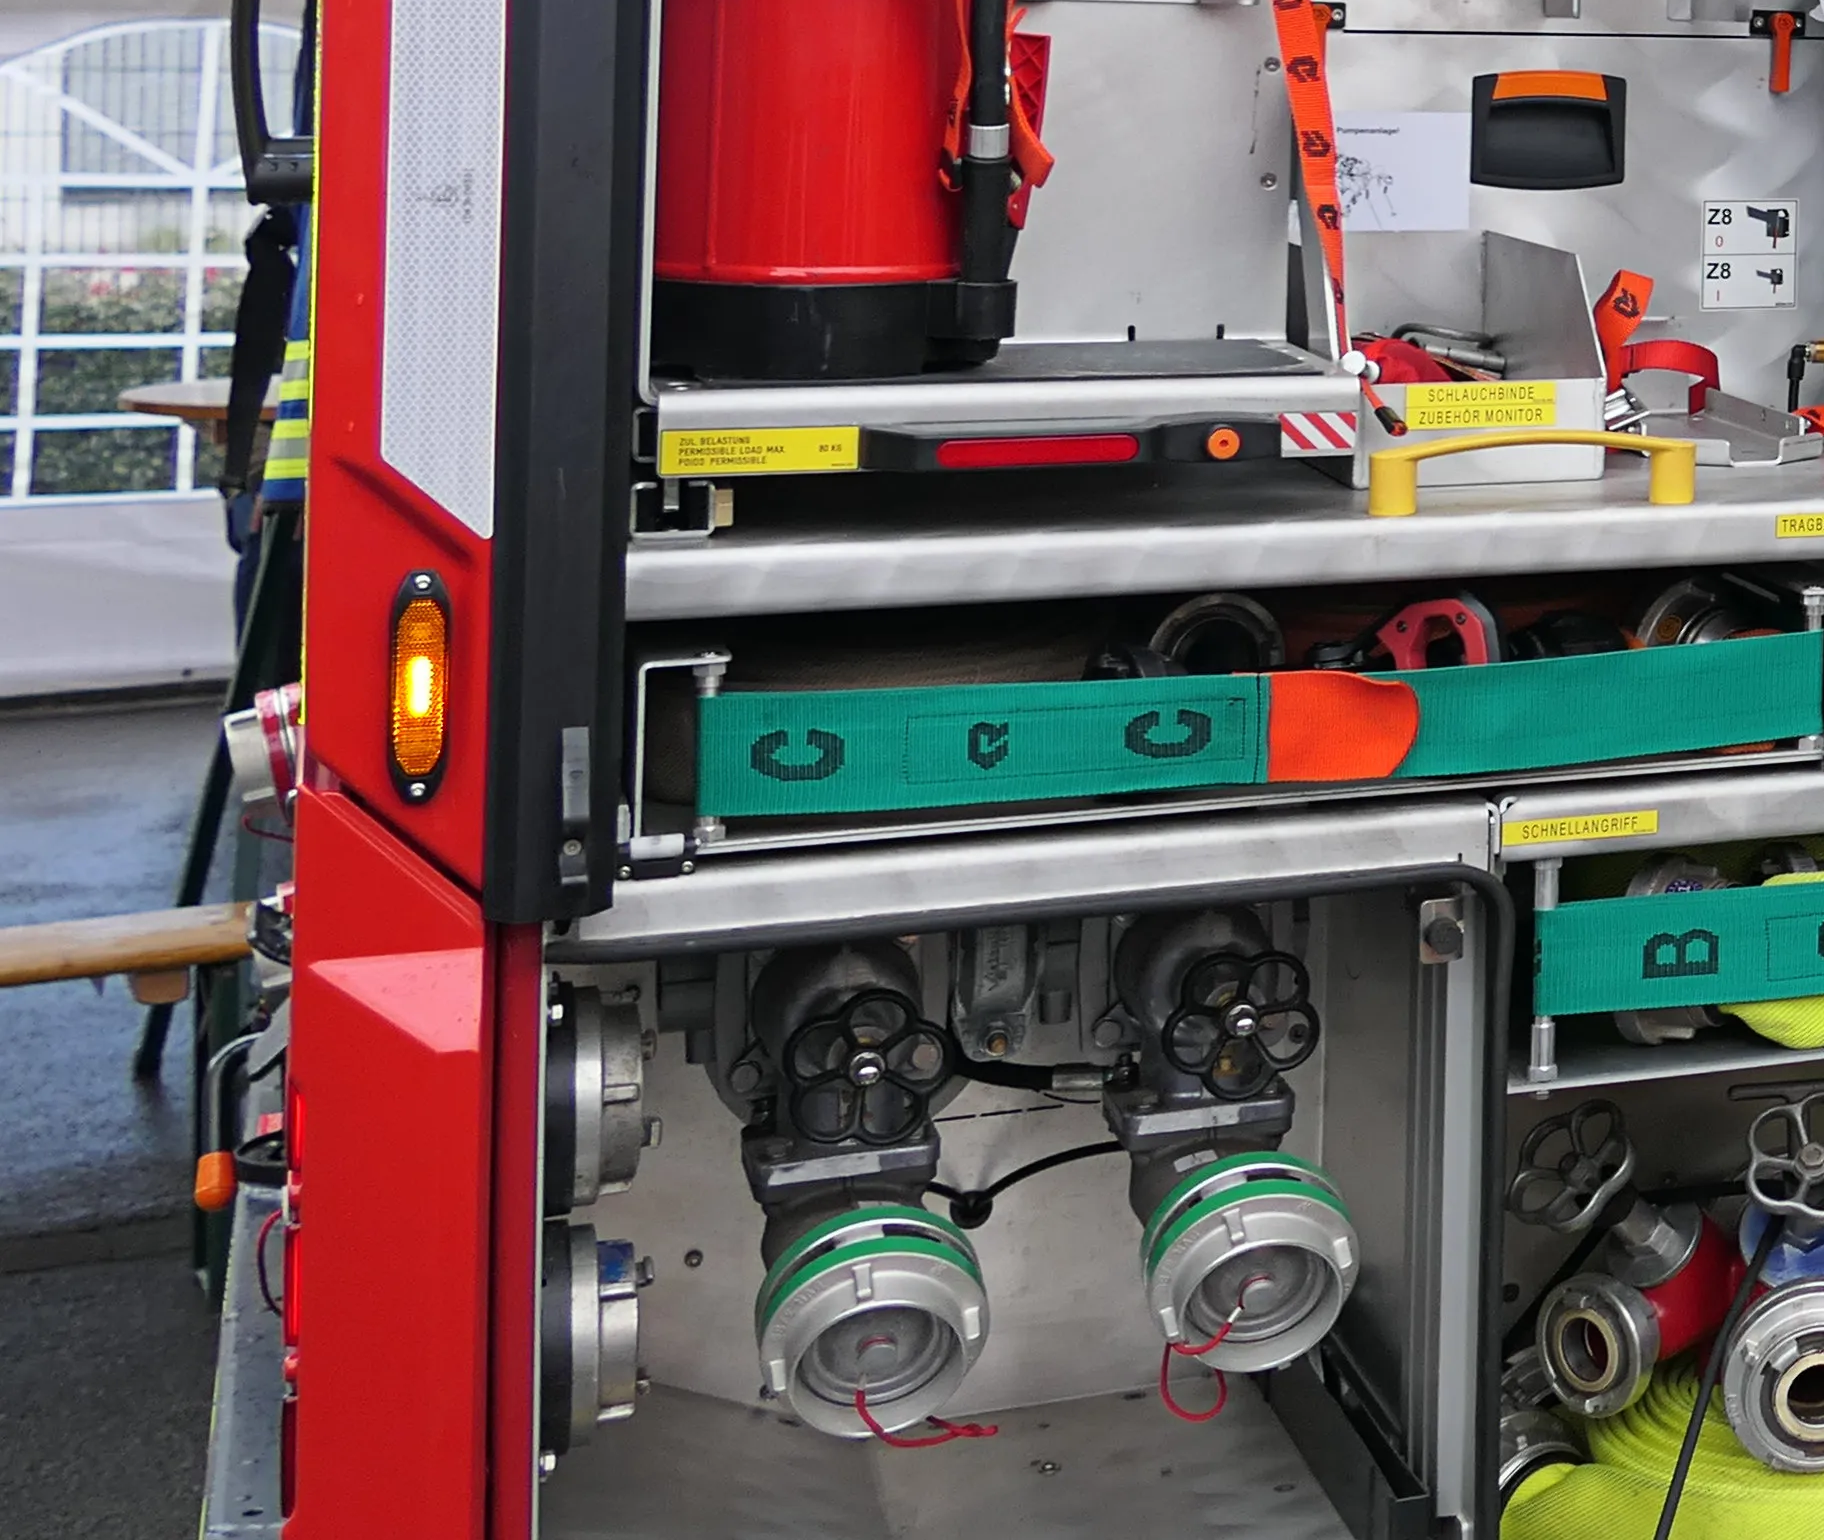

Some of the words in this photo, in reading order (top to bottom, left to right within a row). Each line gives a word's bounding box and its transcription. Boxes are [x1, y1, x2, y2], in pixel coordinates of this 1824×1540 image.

[1708, 208, 1732, 225] Z8
[1707, 262, 1731, 279] Z8
[1427, 386, 1535, 402] SCHLAUCHBINDE
[1419, 408, 1481, 424] ZUBEHÖR
[1485, 408, 1543, 422] MONITOR
[750, 727, 846, 782] C
[1124, 708, 1212, 759] C
[1521, 815, 1639, 839] SCHNELLANGRIFF
[1642, 927, 1720, 980] B
